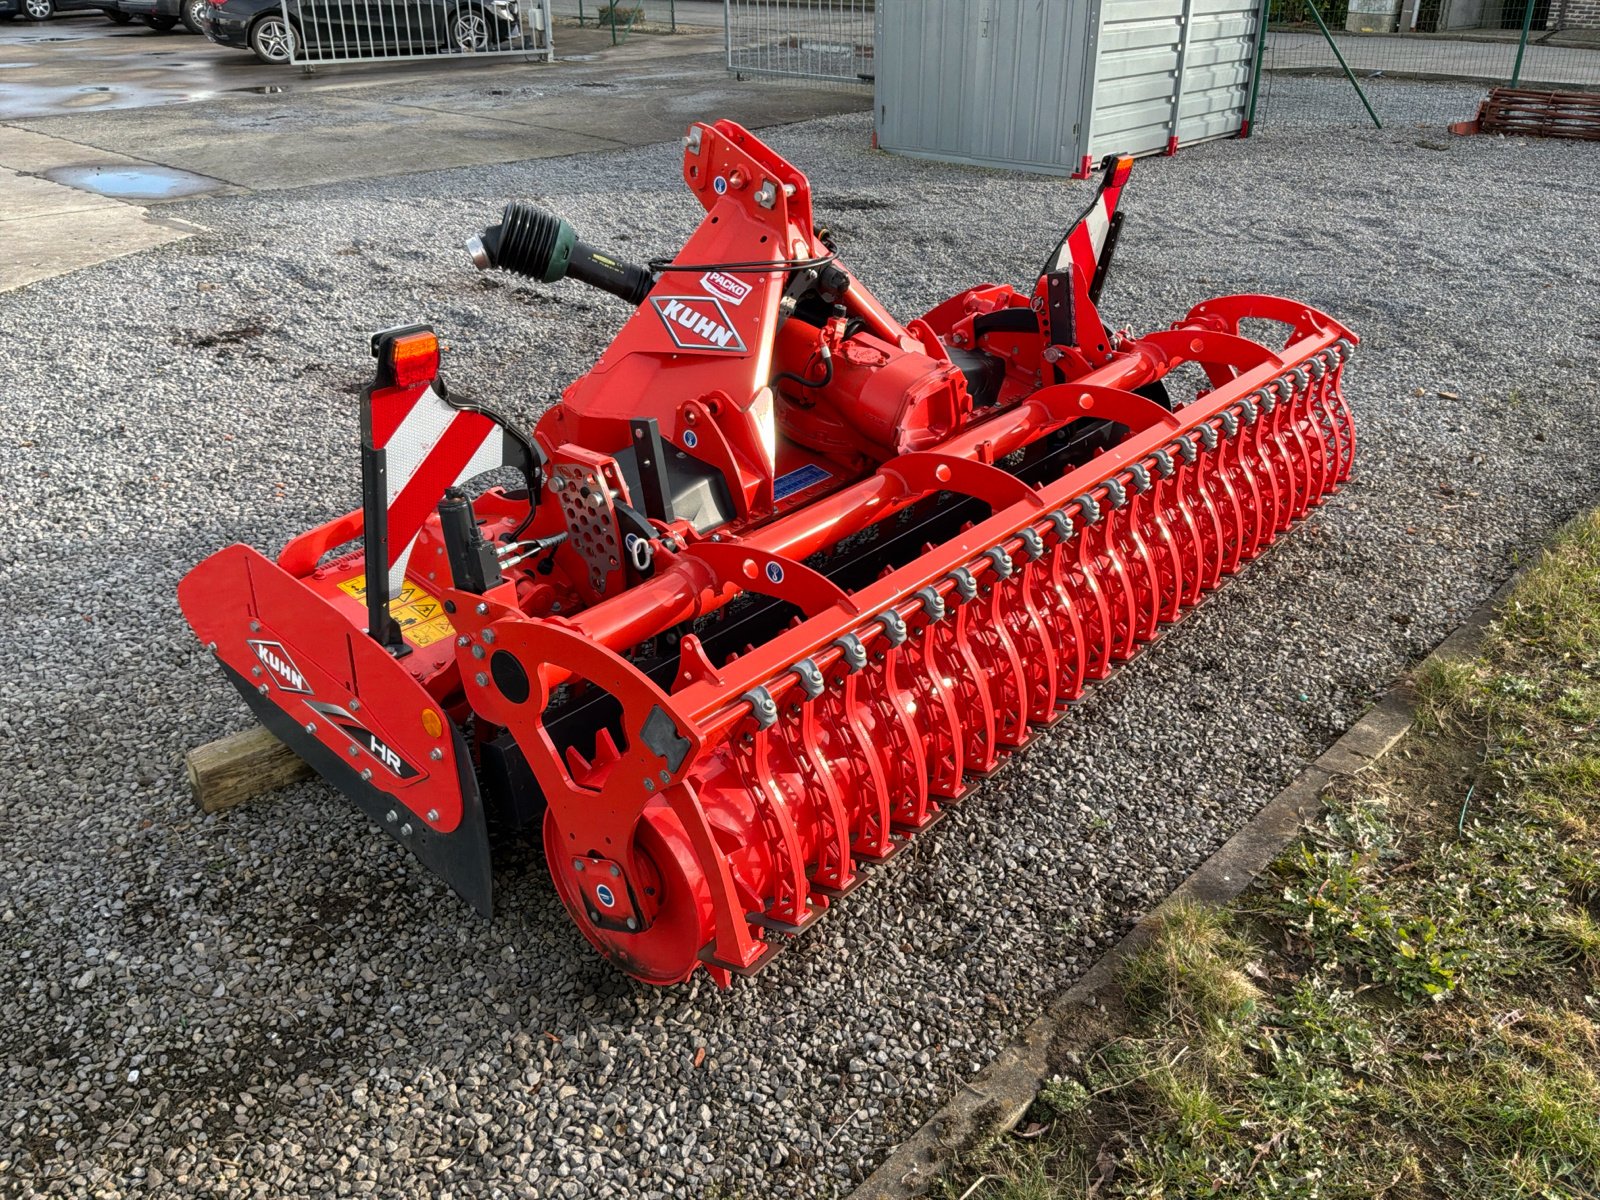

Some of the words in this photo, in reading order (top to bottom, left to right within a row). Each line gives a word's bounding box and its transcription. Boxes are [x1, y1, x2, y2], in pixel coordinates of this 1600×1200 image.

[709, 271, 745, 296] PACKO
[662, 299, 734, 348] KUHN
[258, 643, 303, 690] KUHN
[370, 734, 402, 775] HR
